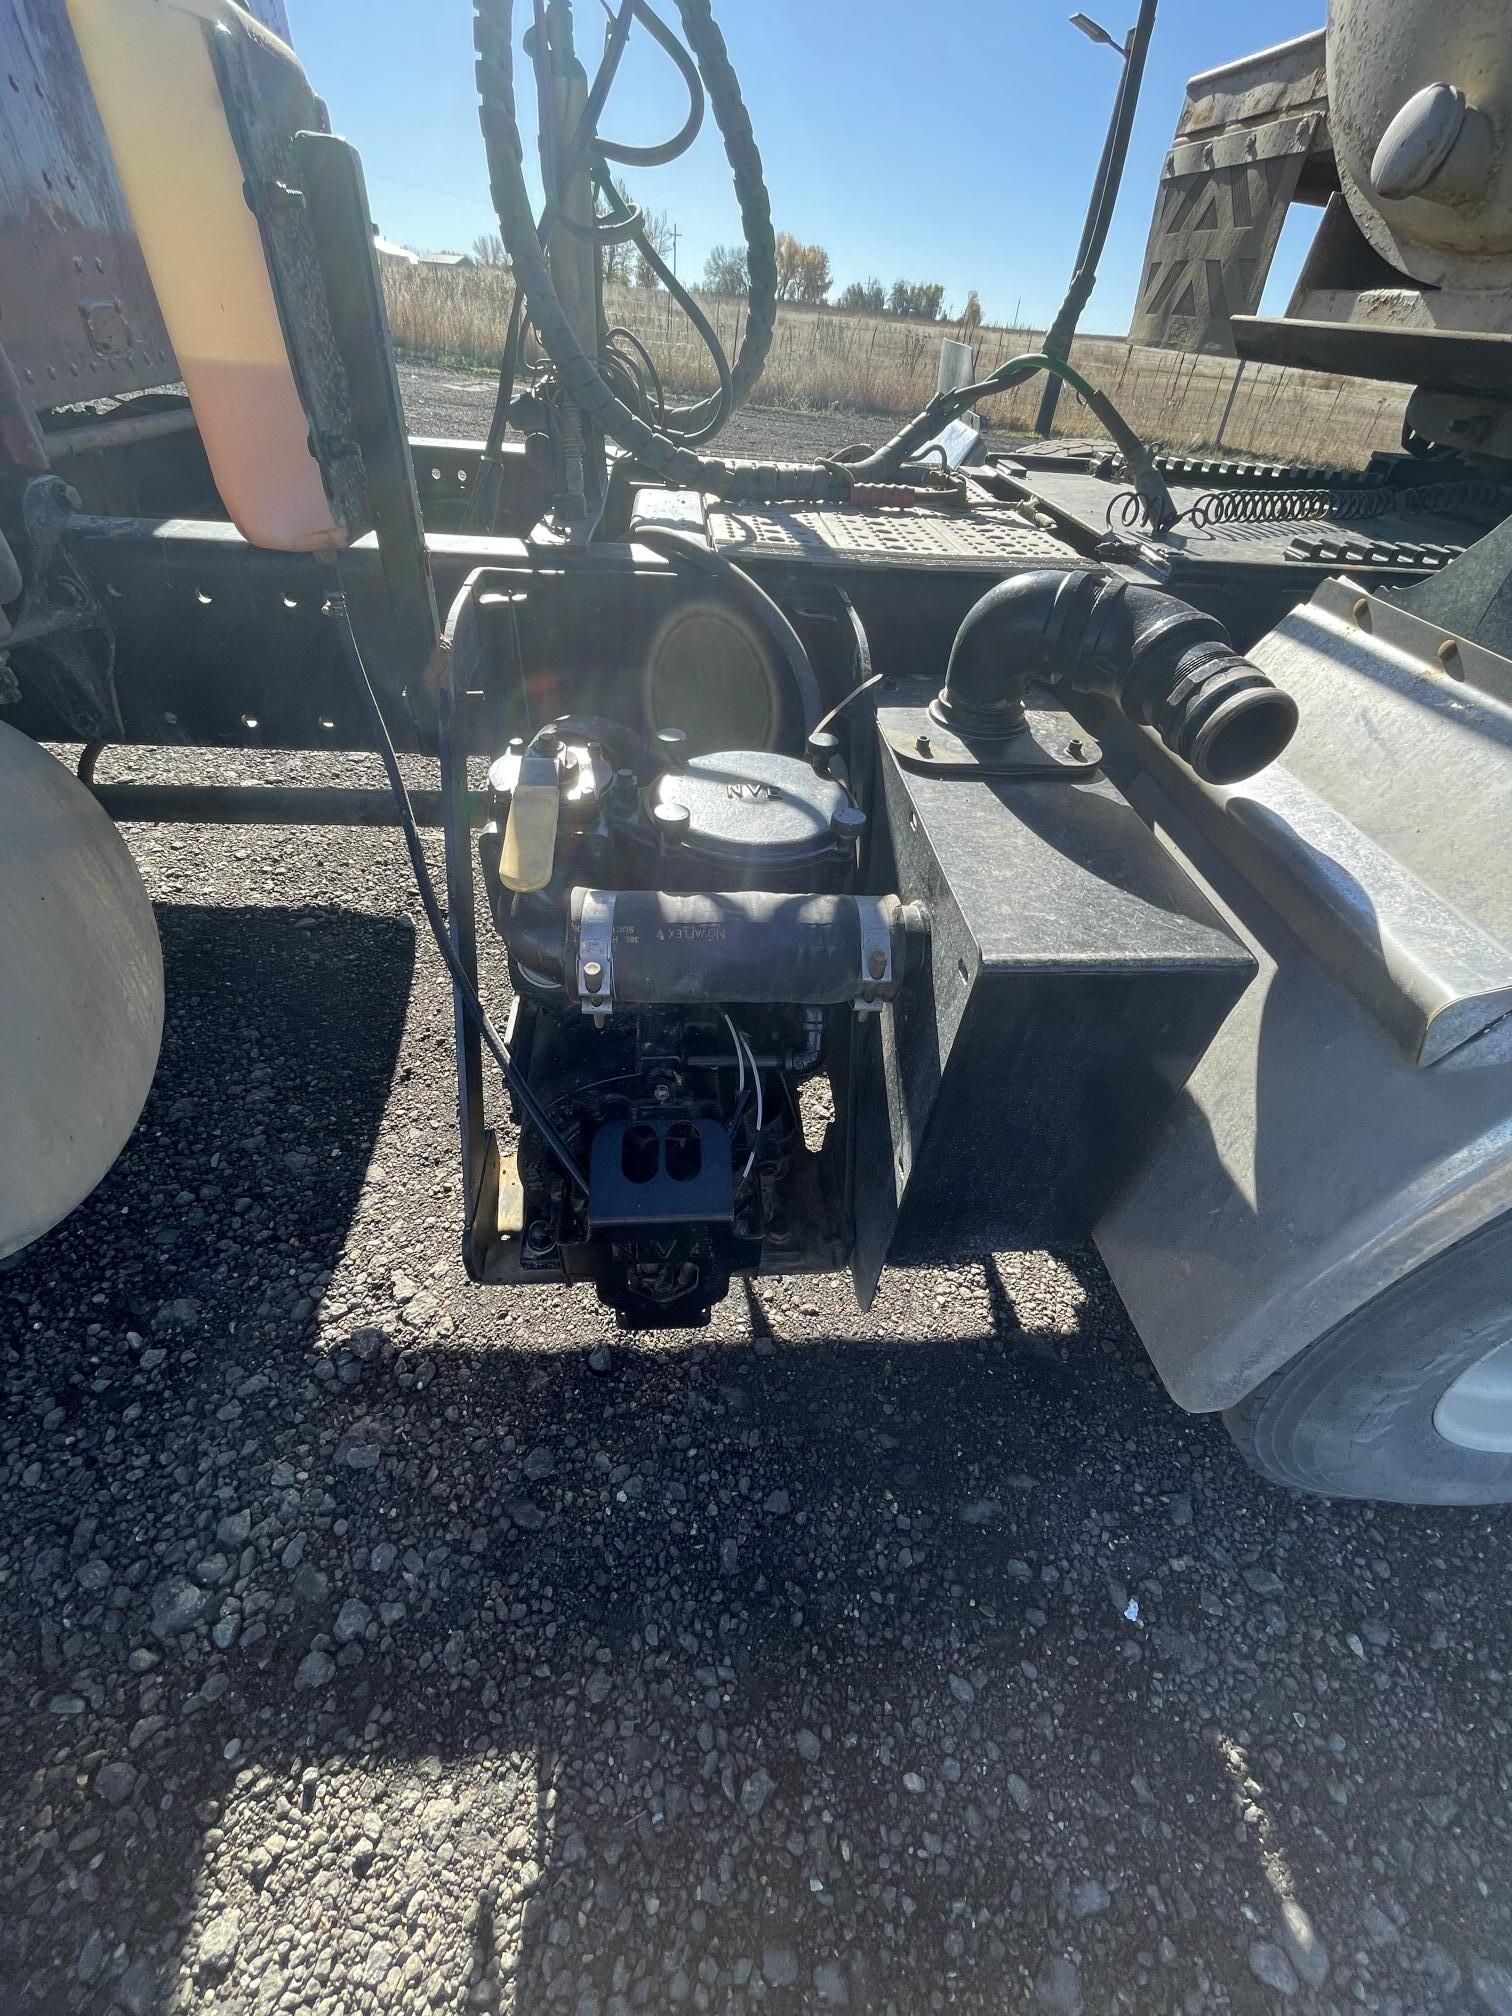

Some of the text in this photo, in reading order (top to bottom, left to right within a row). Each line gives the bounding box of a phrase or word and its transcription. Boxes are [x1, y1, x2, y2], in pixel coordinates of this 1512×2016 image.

[726, 784, 785, 801] NVE
[667, 928, 727, 942] NOVAFLEX
[611, 1239, 714, 1259] NVE
